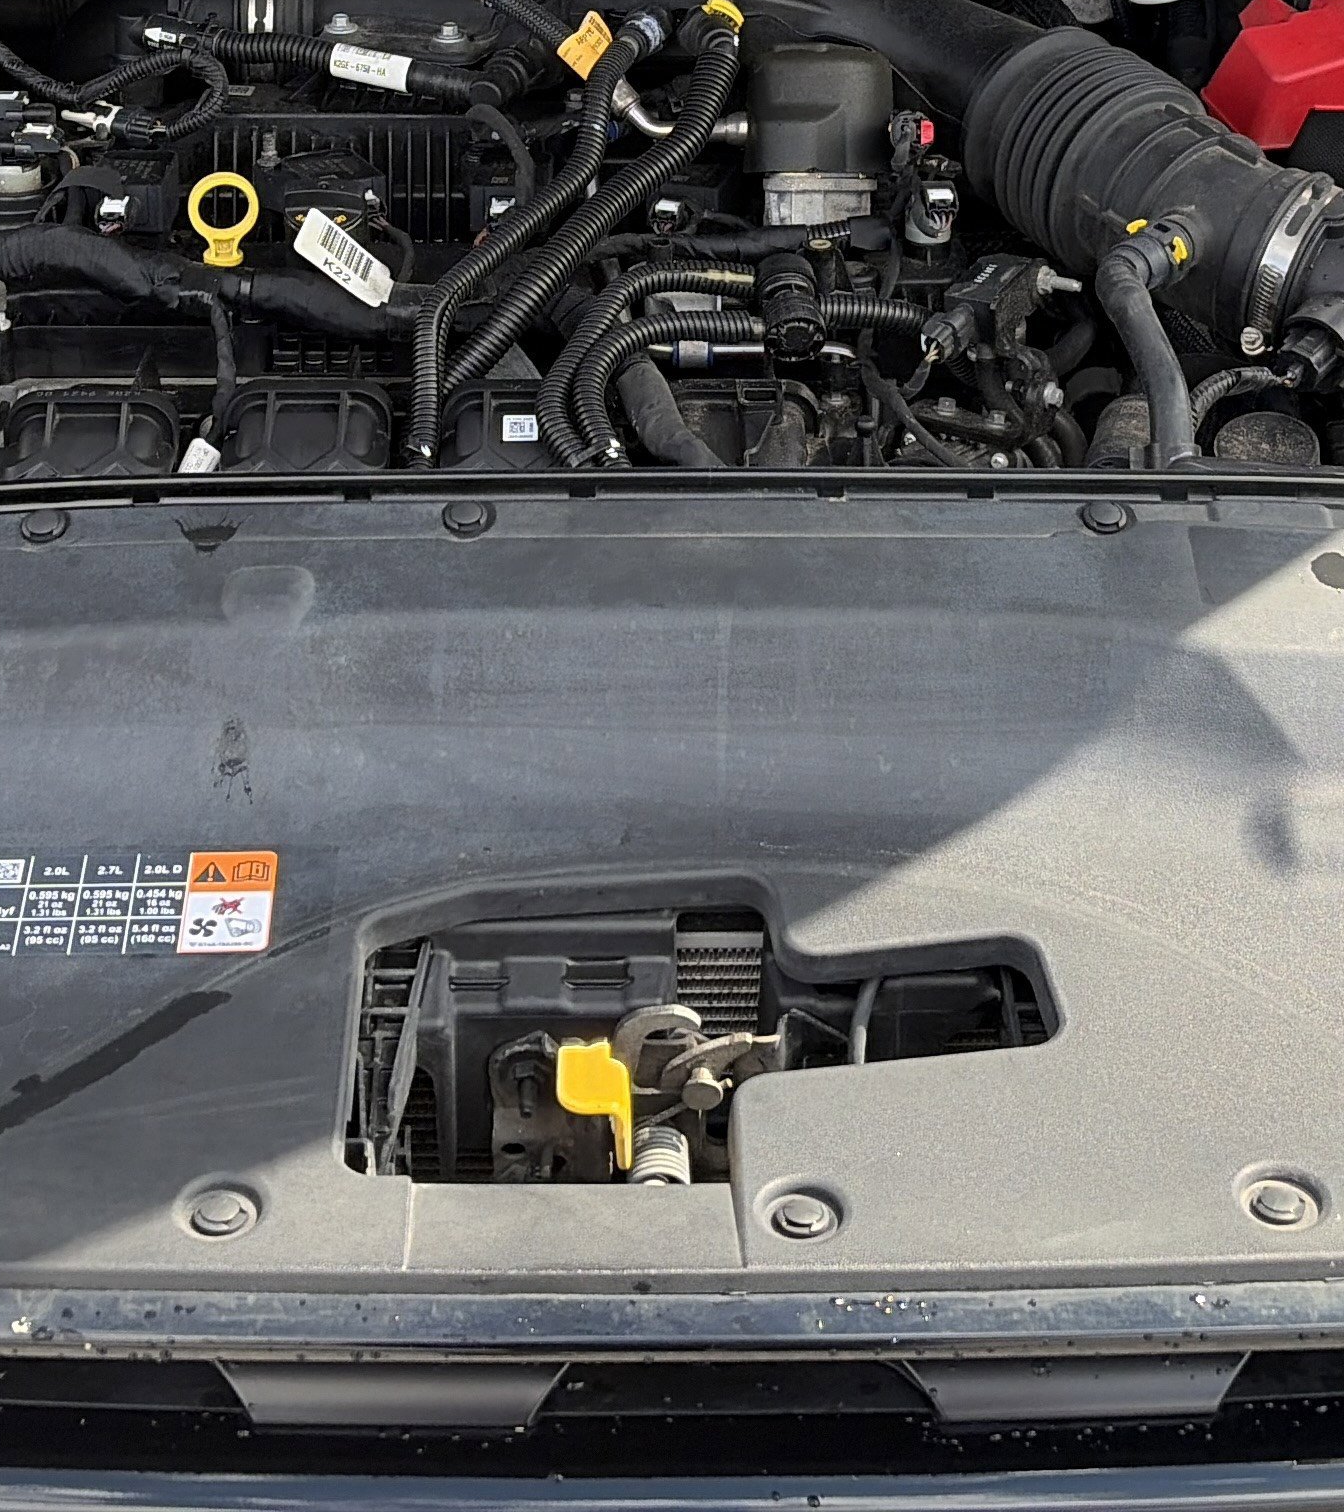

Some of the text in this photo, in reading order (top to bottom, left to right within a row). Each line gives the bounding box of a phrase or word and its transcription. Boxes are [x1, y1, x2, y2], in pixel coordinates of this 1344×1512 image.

[322, 258, 353, 285] K22
[43, 866, 70, 876] 2.0L
[97, 865, 123, 876] 2.7L
[143, 864, 183, 874] 2.0L D
[28, 890, 76, 902] 0.595 kg
[82, 889, 130, 901] 0.595 kg
[136, 888, 183, 901] 0.454 kg
[91, 900, 104, 908] 21
[85, 908, 121, 916] 1.31 lbs
[139, 907, 175, 915] 1.00 lbs
[23, 925, 68, 935] 3.2 fl oz
[78, 925, 96, 934] 3.2
[97, 924, 106, 934] fl
[131, 924, 149, 933] 5.4
[151, 924, 160, 933] fl
[25, 935, 64, 946] (95 cc)
[80, 934, 119, 945] (95 cc)
[130, 934, 176, 945] (160 cc)
